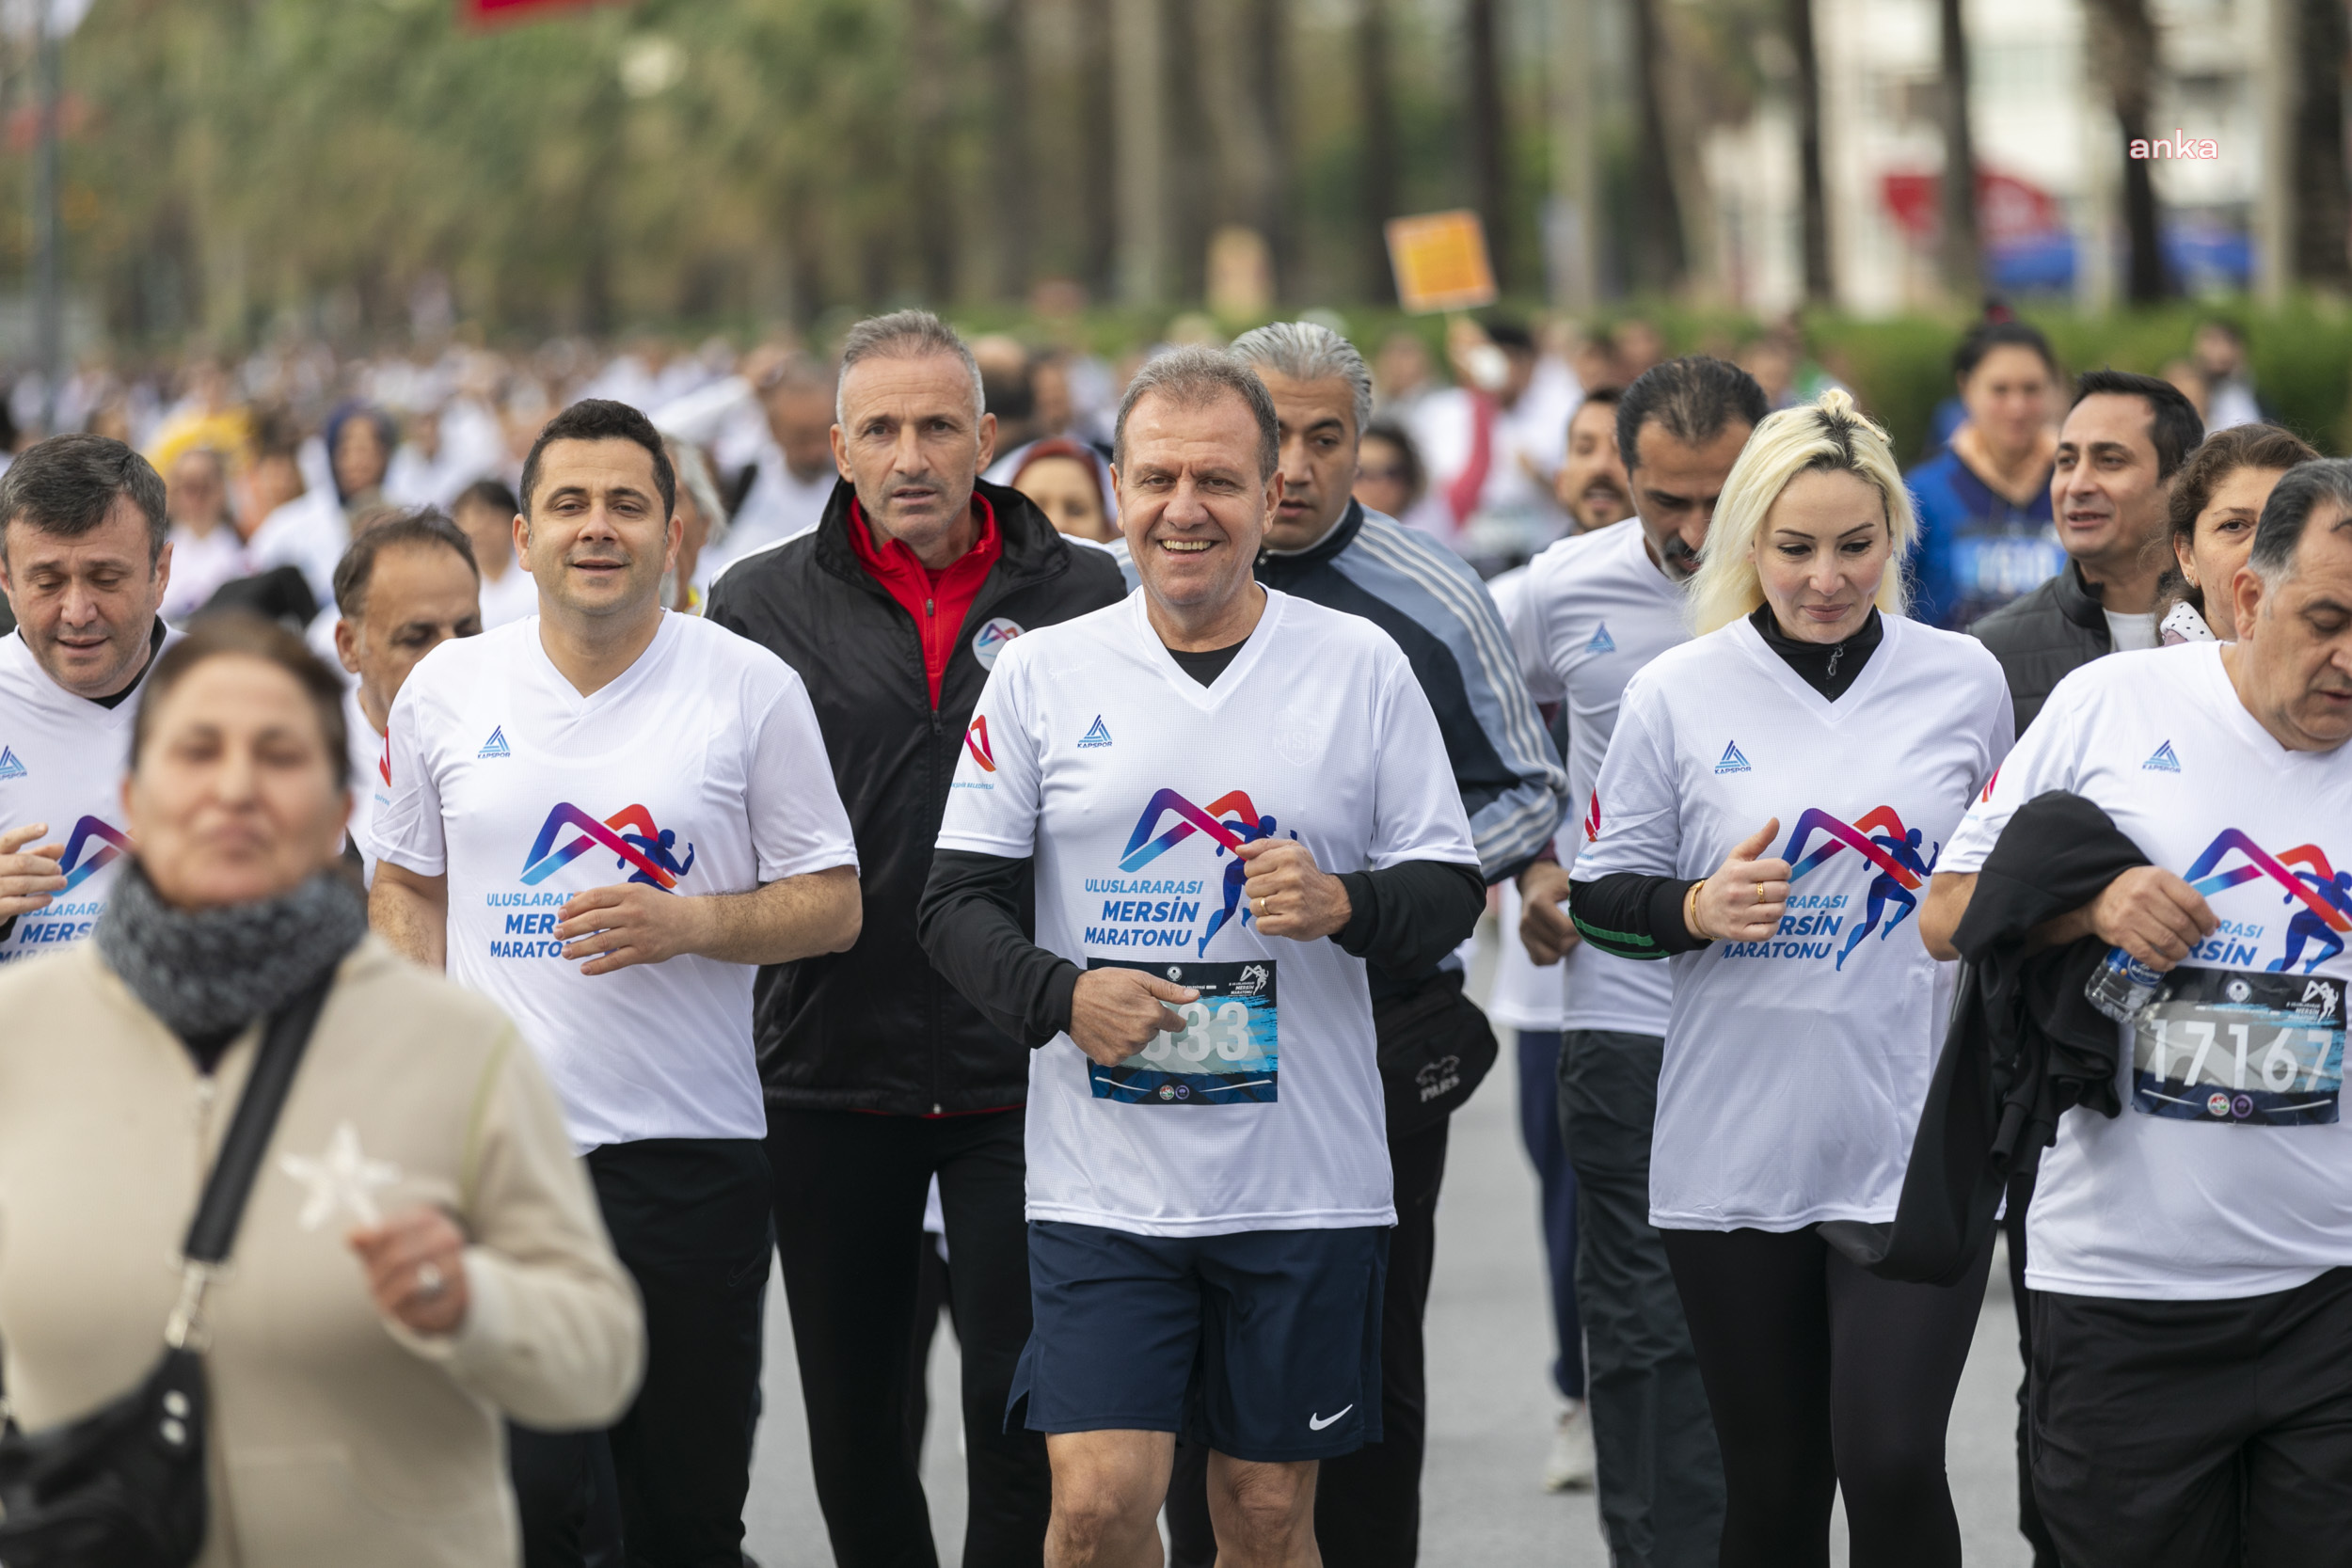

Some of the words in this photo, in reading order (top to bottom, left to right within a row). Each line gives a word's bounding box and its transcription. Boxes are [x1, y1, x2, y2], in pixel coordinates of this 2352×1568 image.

[1076, 741, 1113, 750] KAPSPOR
[1714, 766, 1752, 774] KAPSPOR
[2142, 764, 2181, 774] KAPSPOR
[1084, 879, 1204, 895] ULUSLARARASI
[1102, 895, 1200, 924] MERSİN
[1786, 895, 1850, 909] RARASI
[20, 922, 102, 944] MERS
[505, 913, 564, 934] MER
[1776, 910, 1844, 937] RSİN
[2217, 919, 2265, 939] RASI
[1084, 927, 1193, 947] MARATONU
[490, 941, 574, 958] MARATO
[2150, 1018, 2334, 1094] 17167
